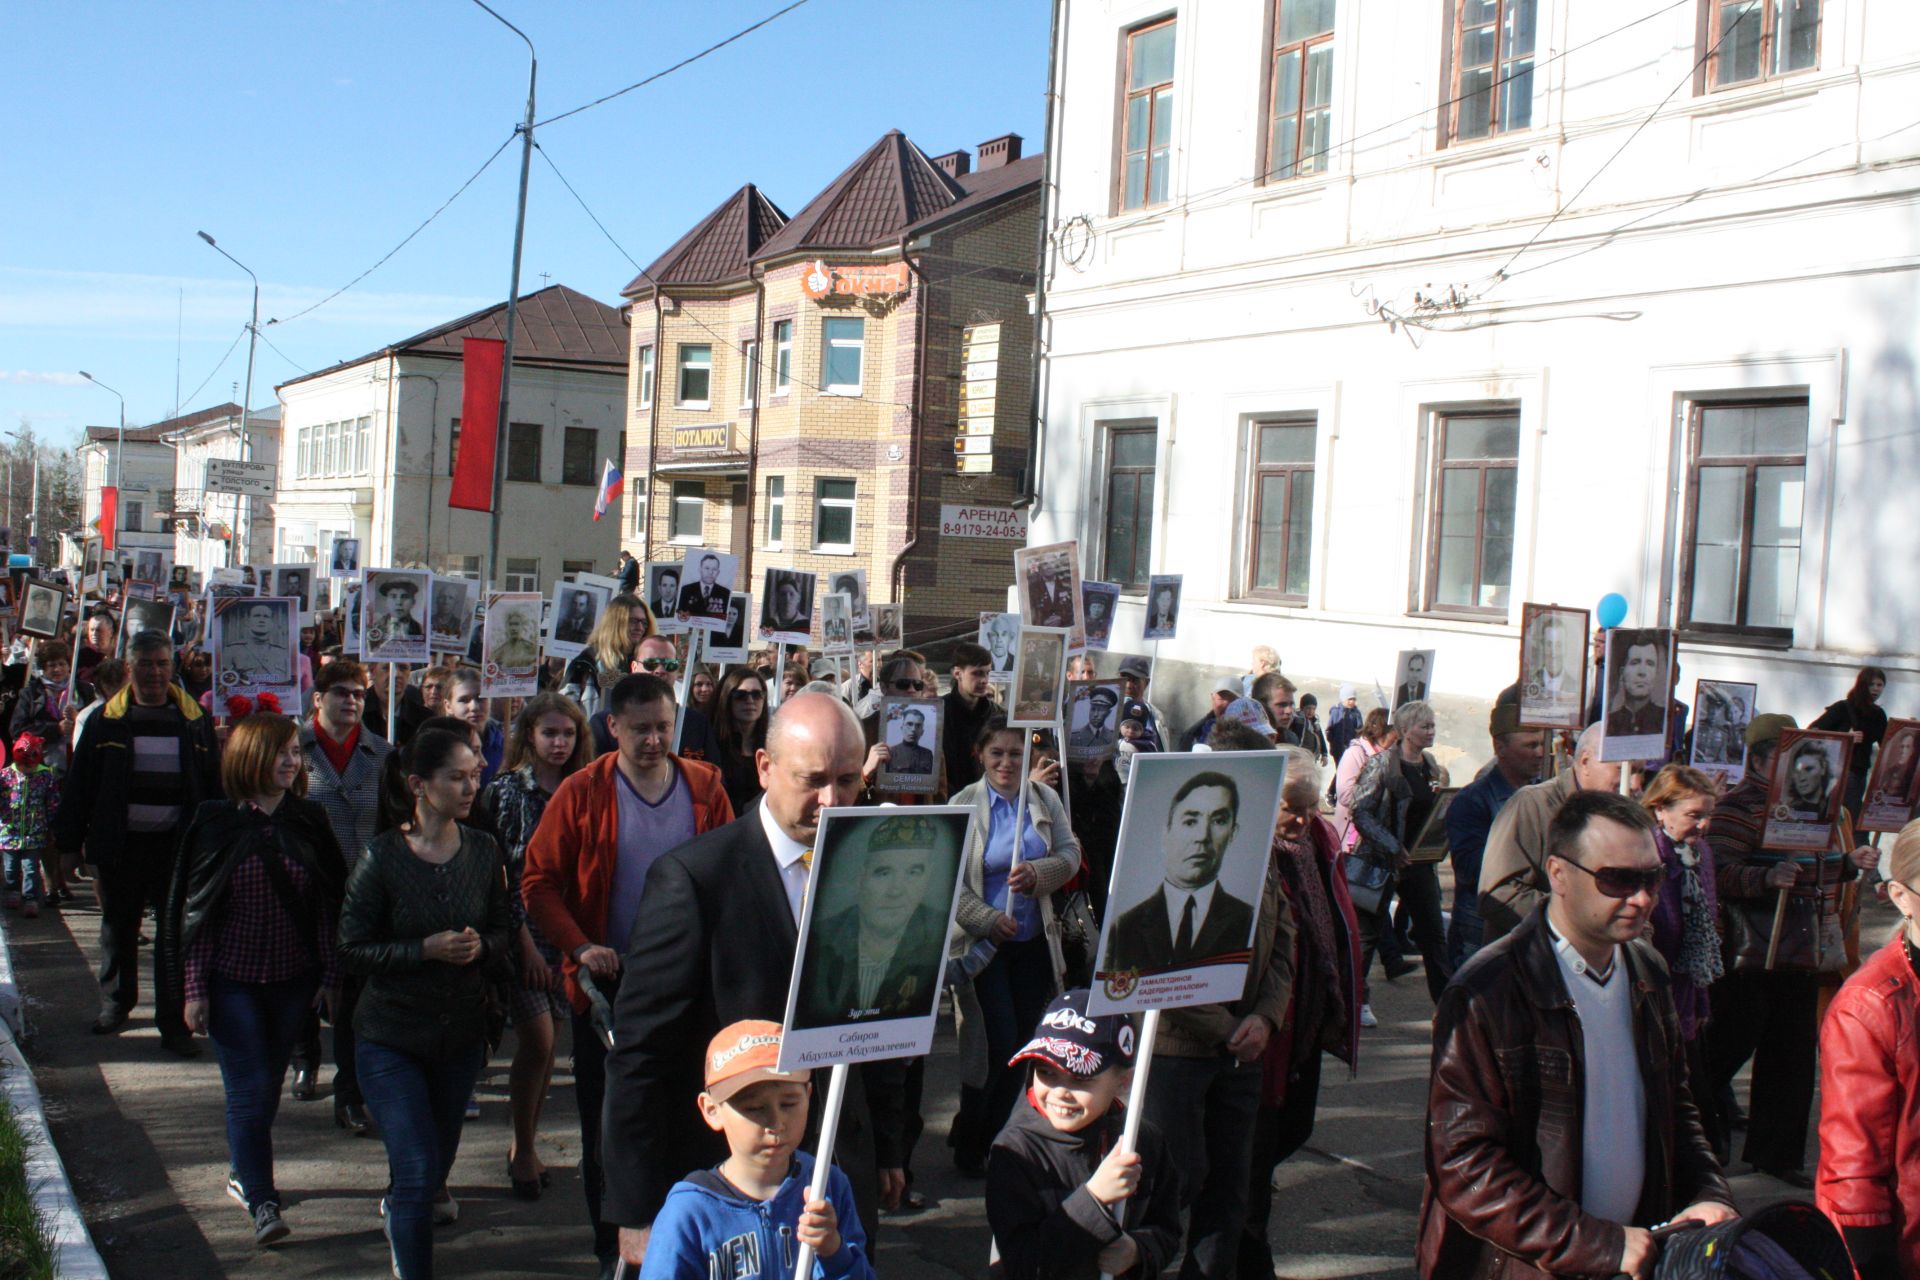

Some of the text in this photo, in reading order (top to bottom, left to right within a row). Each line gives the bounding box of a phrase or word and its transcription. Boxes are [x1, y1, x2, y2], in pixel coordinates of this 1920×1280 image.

[675, 427, 726, 447] НОТАРИУС
[221, 462, 265, 471] БУТЛЕРОВА
[221, 475, 260, 487] ТОЛСТОГО
[958, 508, 1018, 524] АРЕНДА
[894, 775, 922, 783] СЕМИН
[839, 1031, 880, 1043] Сабиров
[798, 1041, 916, 1062] Абдулхак Абдулвалеевич
